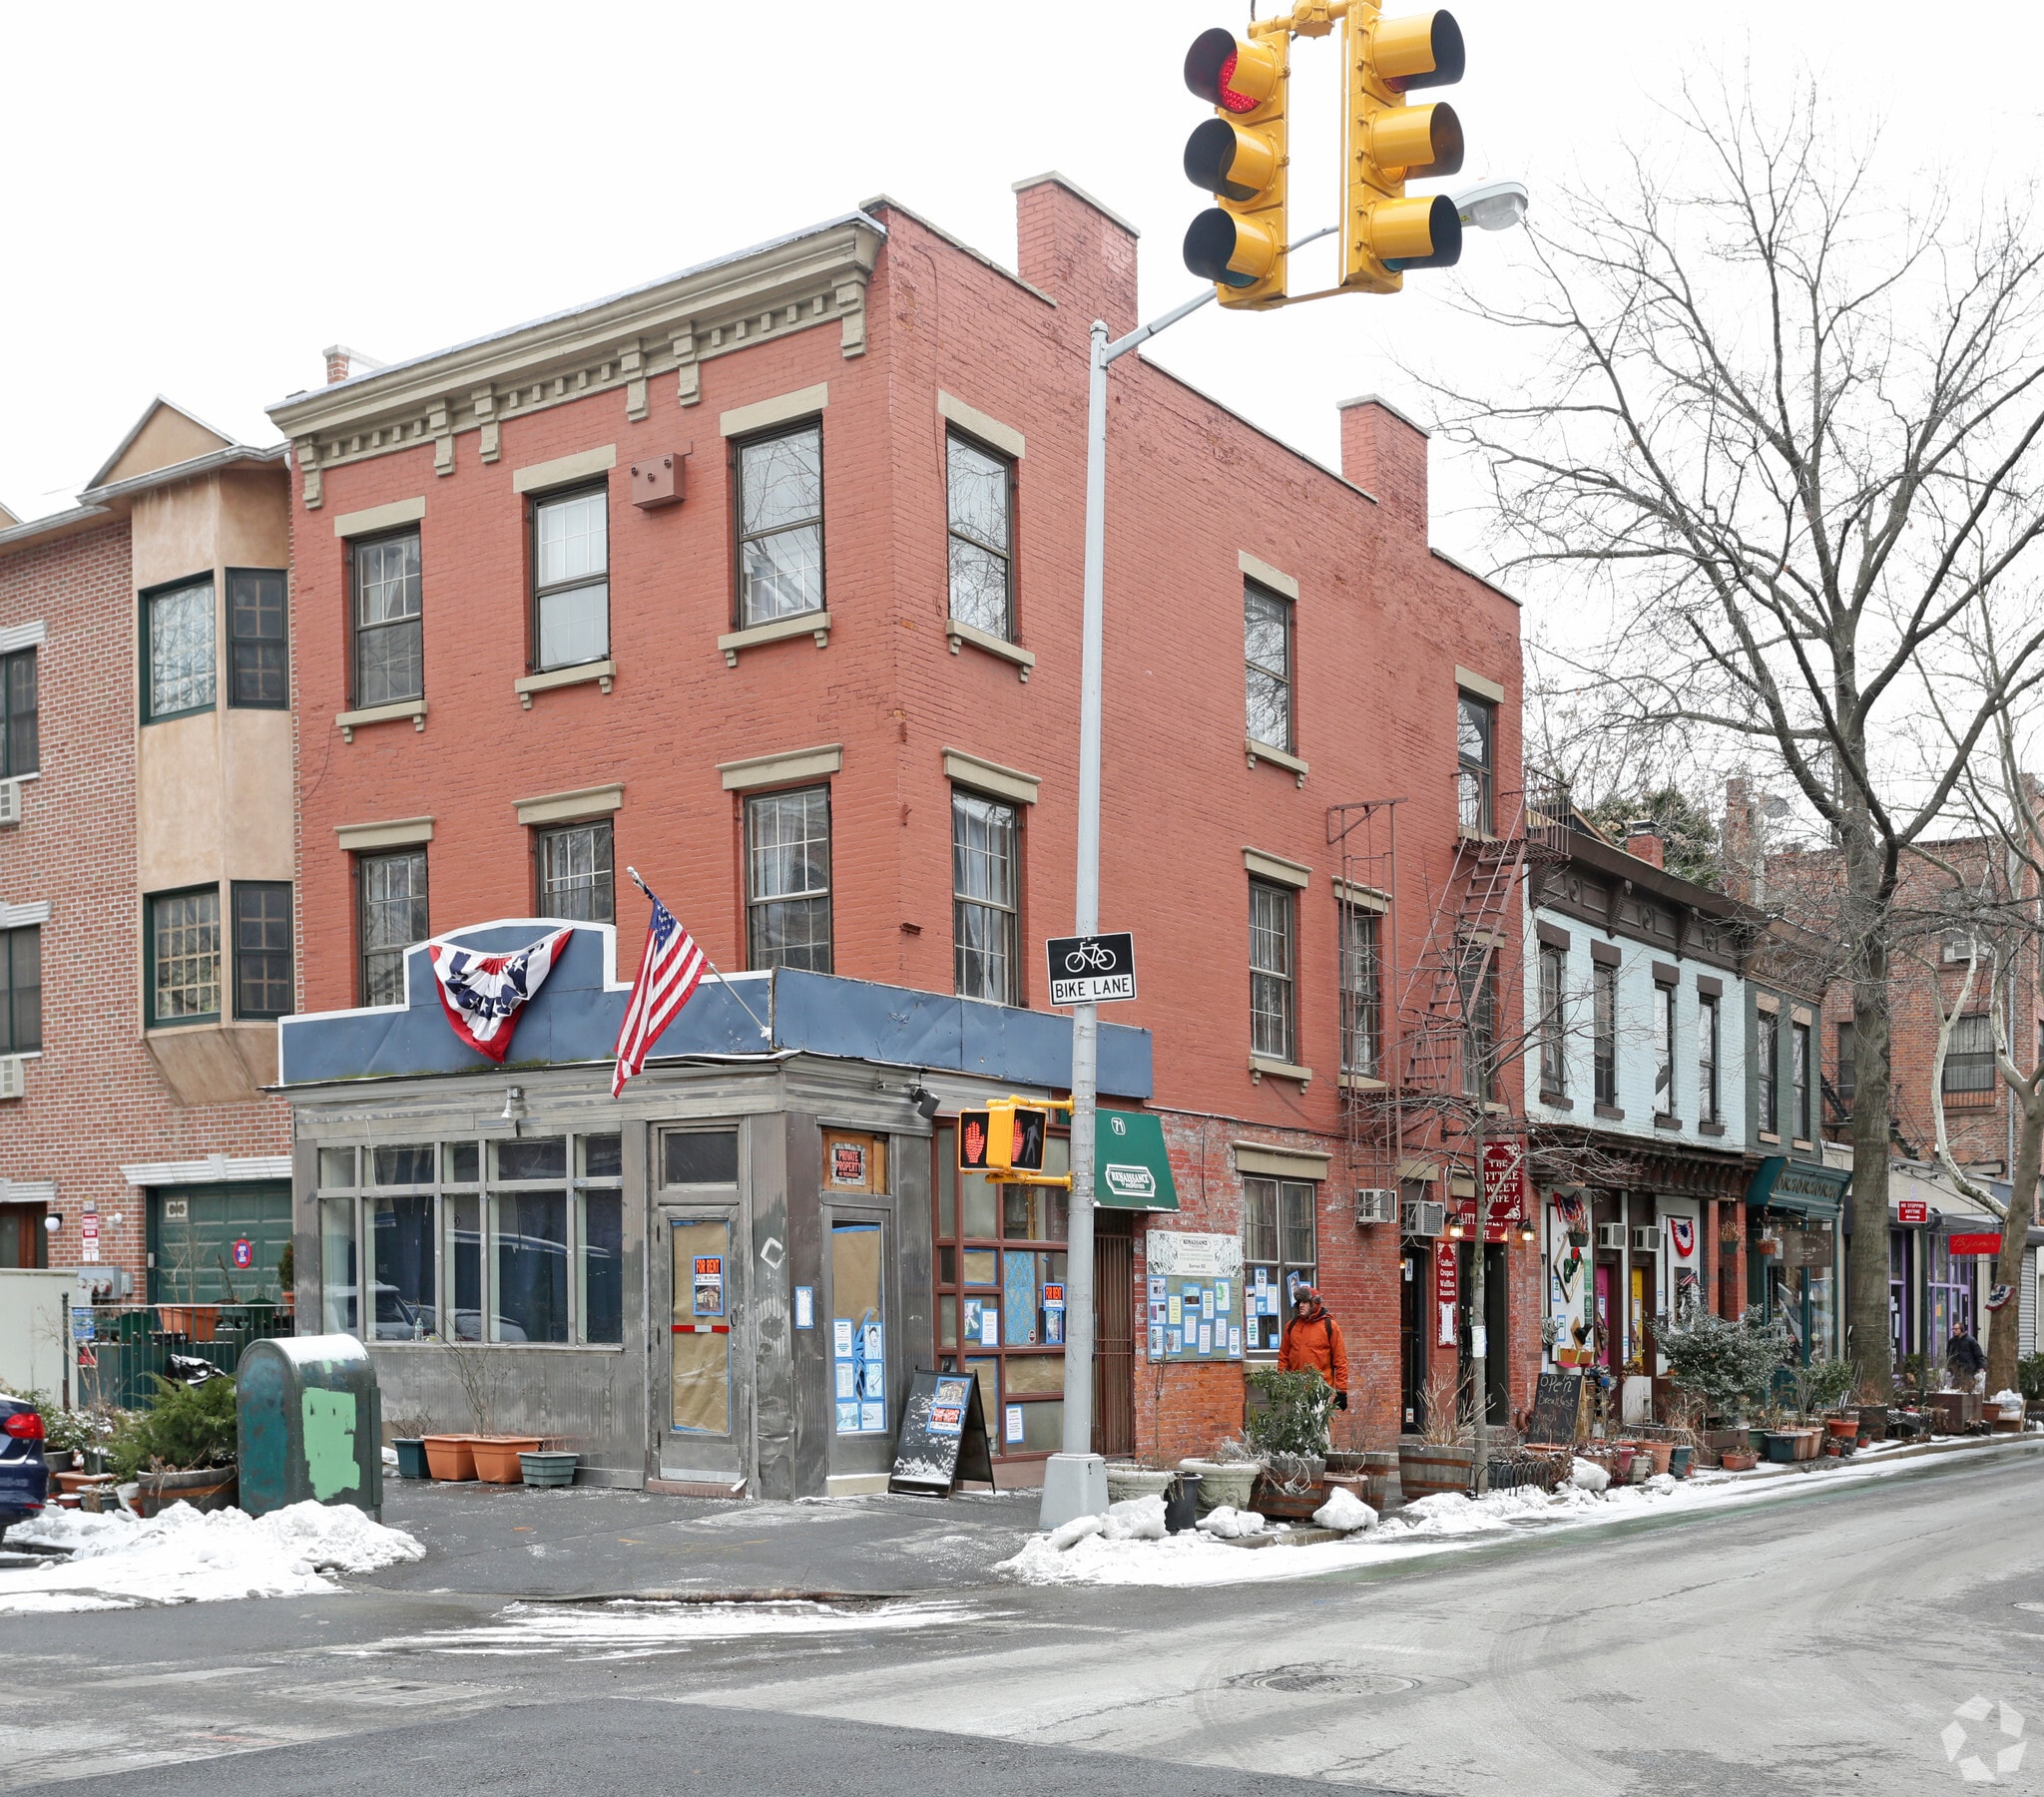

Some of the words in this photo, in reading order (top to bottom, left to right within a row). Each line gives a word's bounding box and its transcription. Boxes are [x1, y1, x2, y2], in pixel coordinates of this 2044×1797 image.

[1055, 981, 1086, 998] BIKE
[1093, 977, 1130, 995] LANE
[1113, 1120, 1124, 1132] 71
[838, 1149, 858, 1162] PRIVATE
[836, 1160, 861, 1172] PROPERTY
[1488, 1159, 1508, 1168] THE
[1111, 1171, 1150, 1185] RENAISSANCE
[696, 1258, 706, 1273] FOR
[706, 1258, 719, 1273] RENT
[1053, 1286, 1062, 1300] RENT
